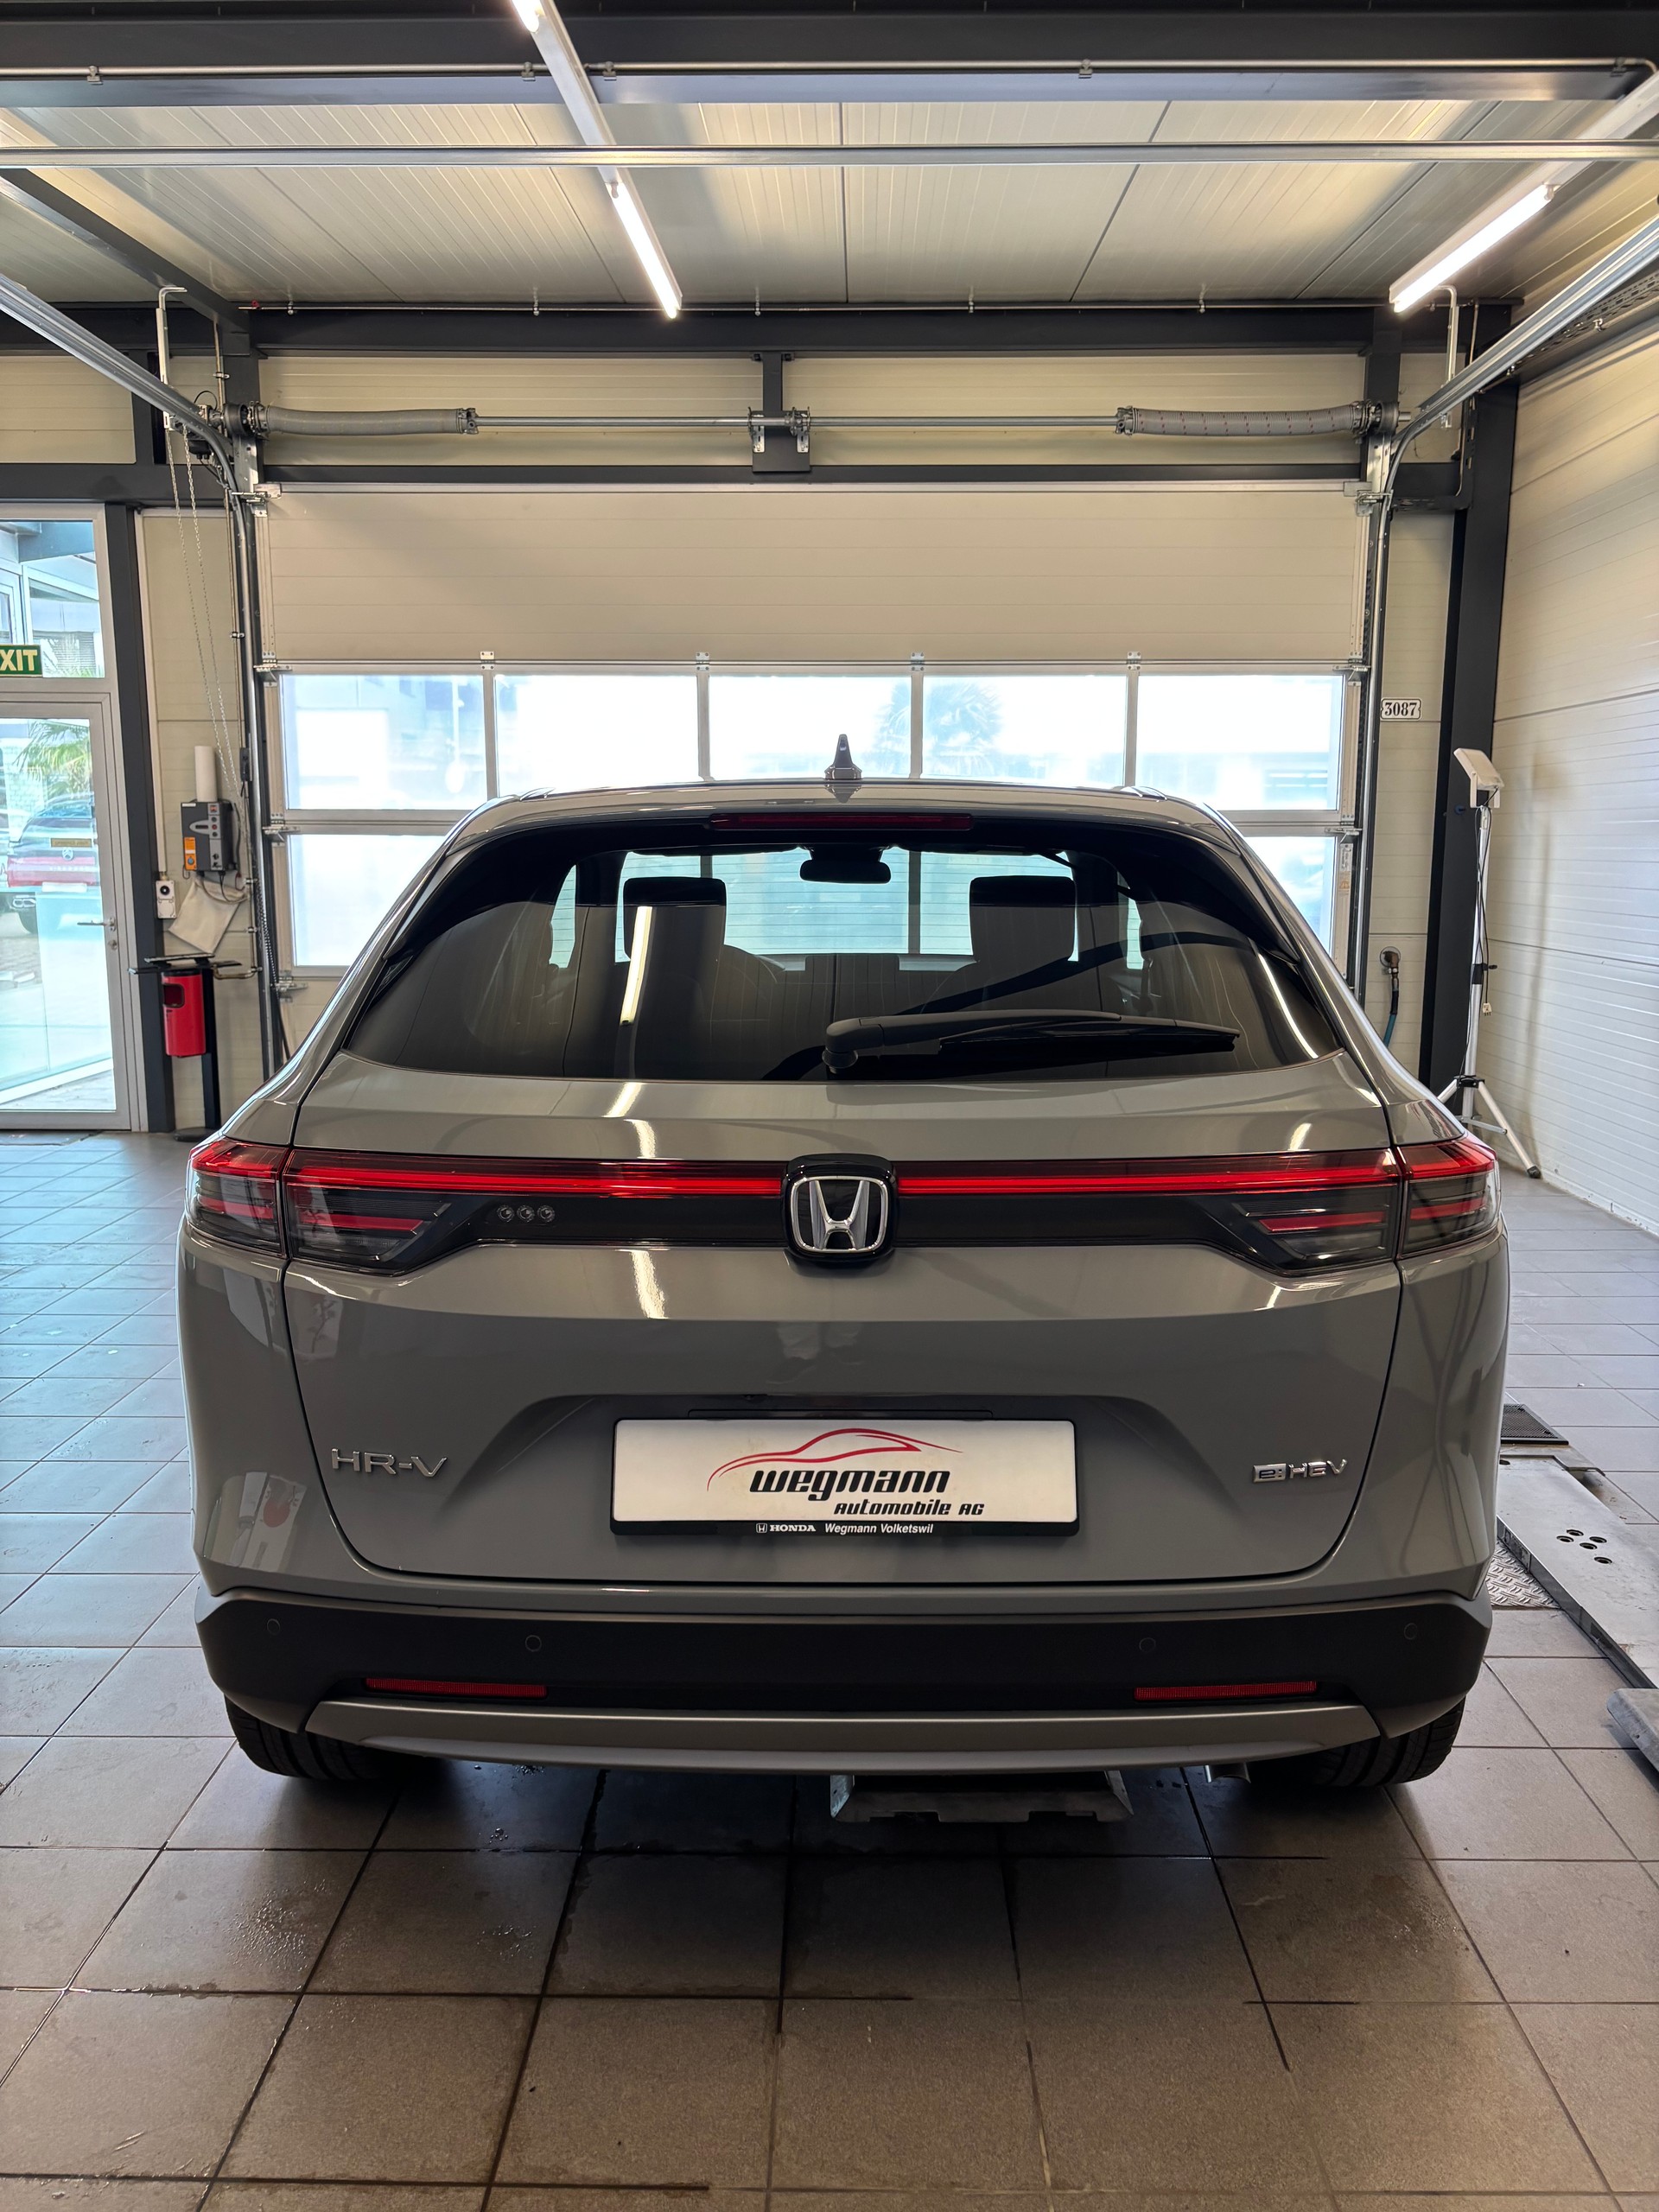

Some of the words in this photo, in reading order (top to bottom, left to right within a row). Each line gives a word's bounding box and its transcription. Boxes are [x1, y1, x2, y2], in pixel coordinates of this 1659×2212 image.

[0, 649, 38, 671] XIT
[1384, 702, 1418, 716] 3087
[331, 1448, 448, 1478] HR-V
[749, 1470, 950, 1502] wegmann
[957, 1503, 985, 1516] AG
[770, 1524, 817, 1533] HONDA
[824, 1523, 877, 1535] Wegmann
[880, 1523, 934, 1534] Volketswil
